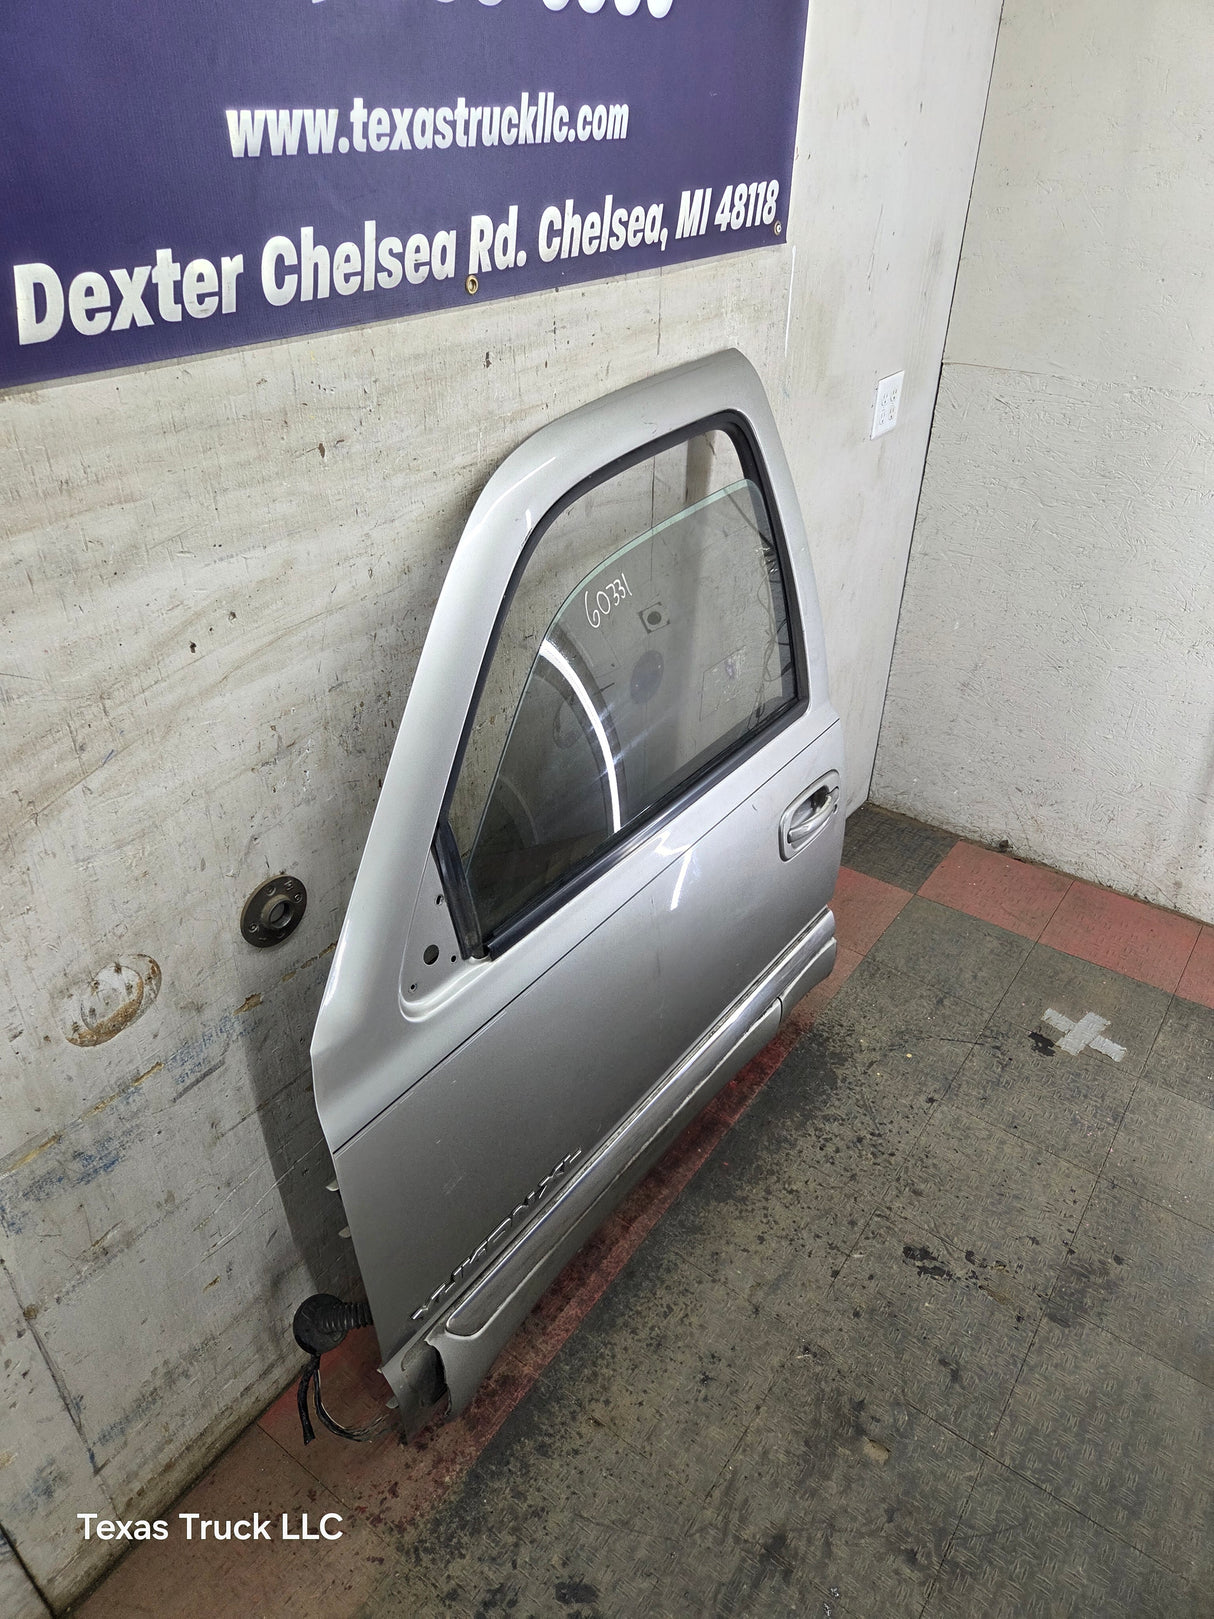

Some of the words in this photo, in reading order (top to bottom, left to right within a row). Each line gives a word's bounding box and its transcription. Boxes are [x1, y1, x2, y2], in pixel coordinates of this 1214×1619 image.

[225, 92, 629, 158] www.texastruckllc.com
[13, 247, 244, 345] Dexter
[260, 219, 457, 307] Chelsea
[468, 204, 527, 275] Rd.
[538, 194, 668, 263] Chelsea,
[674, 187, 713, 239] MI
[714, 179, 780, 233] 48118
[584, 572, 633, 629] 60331
